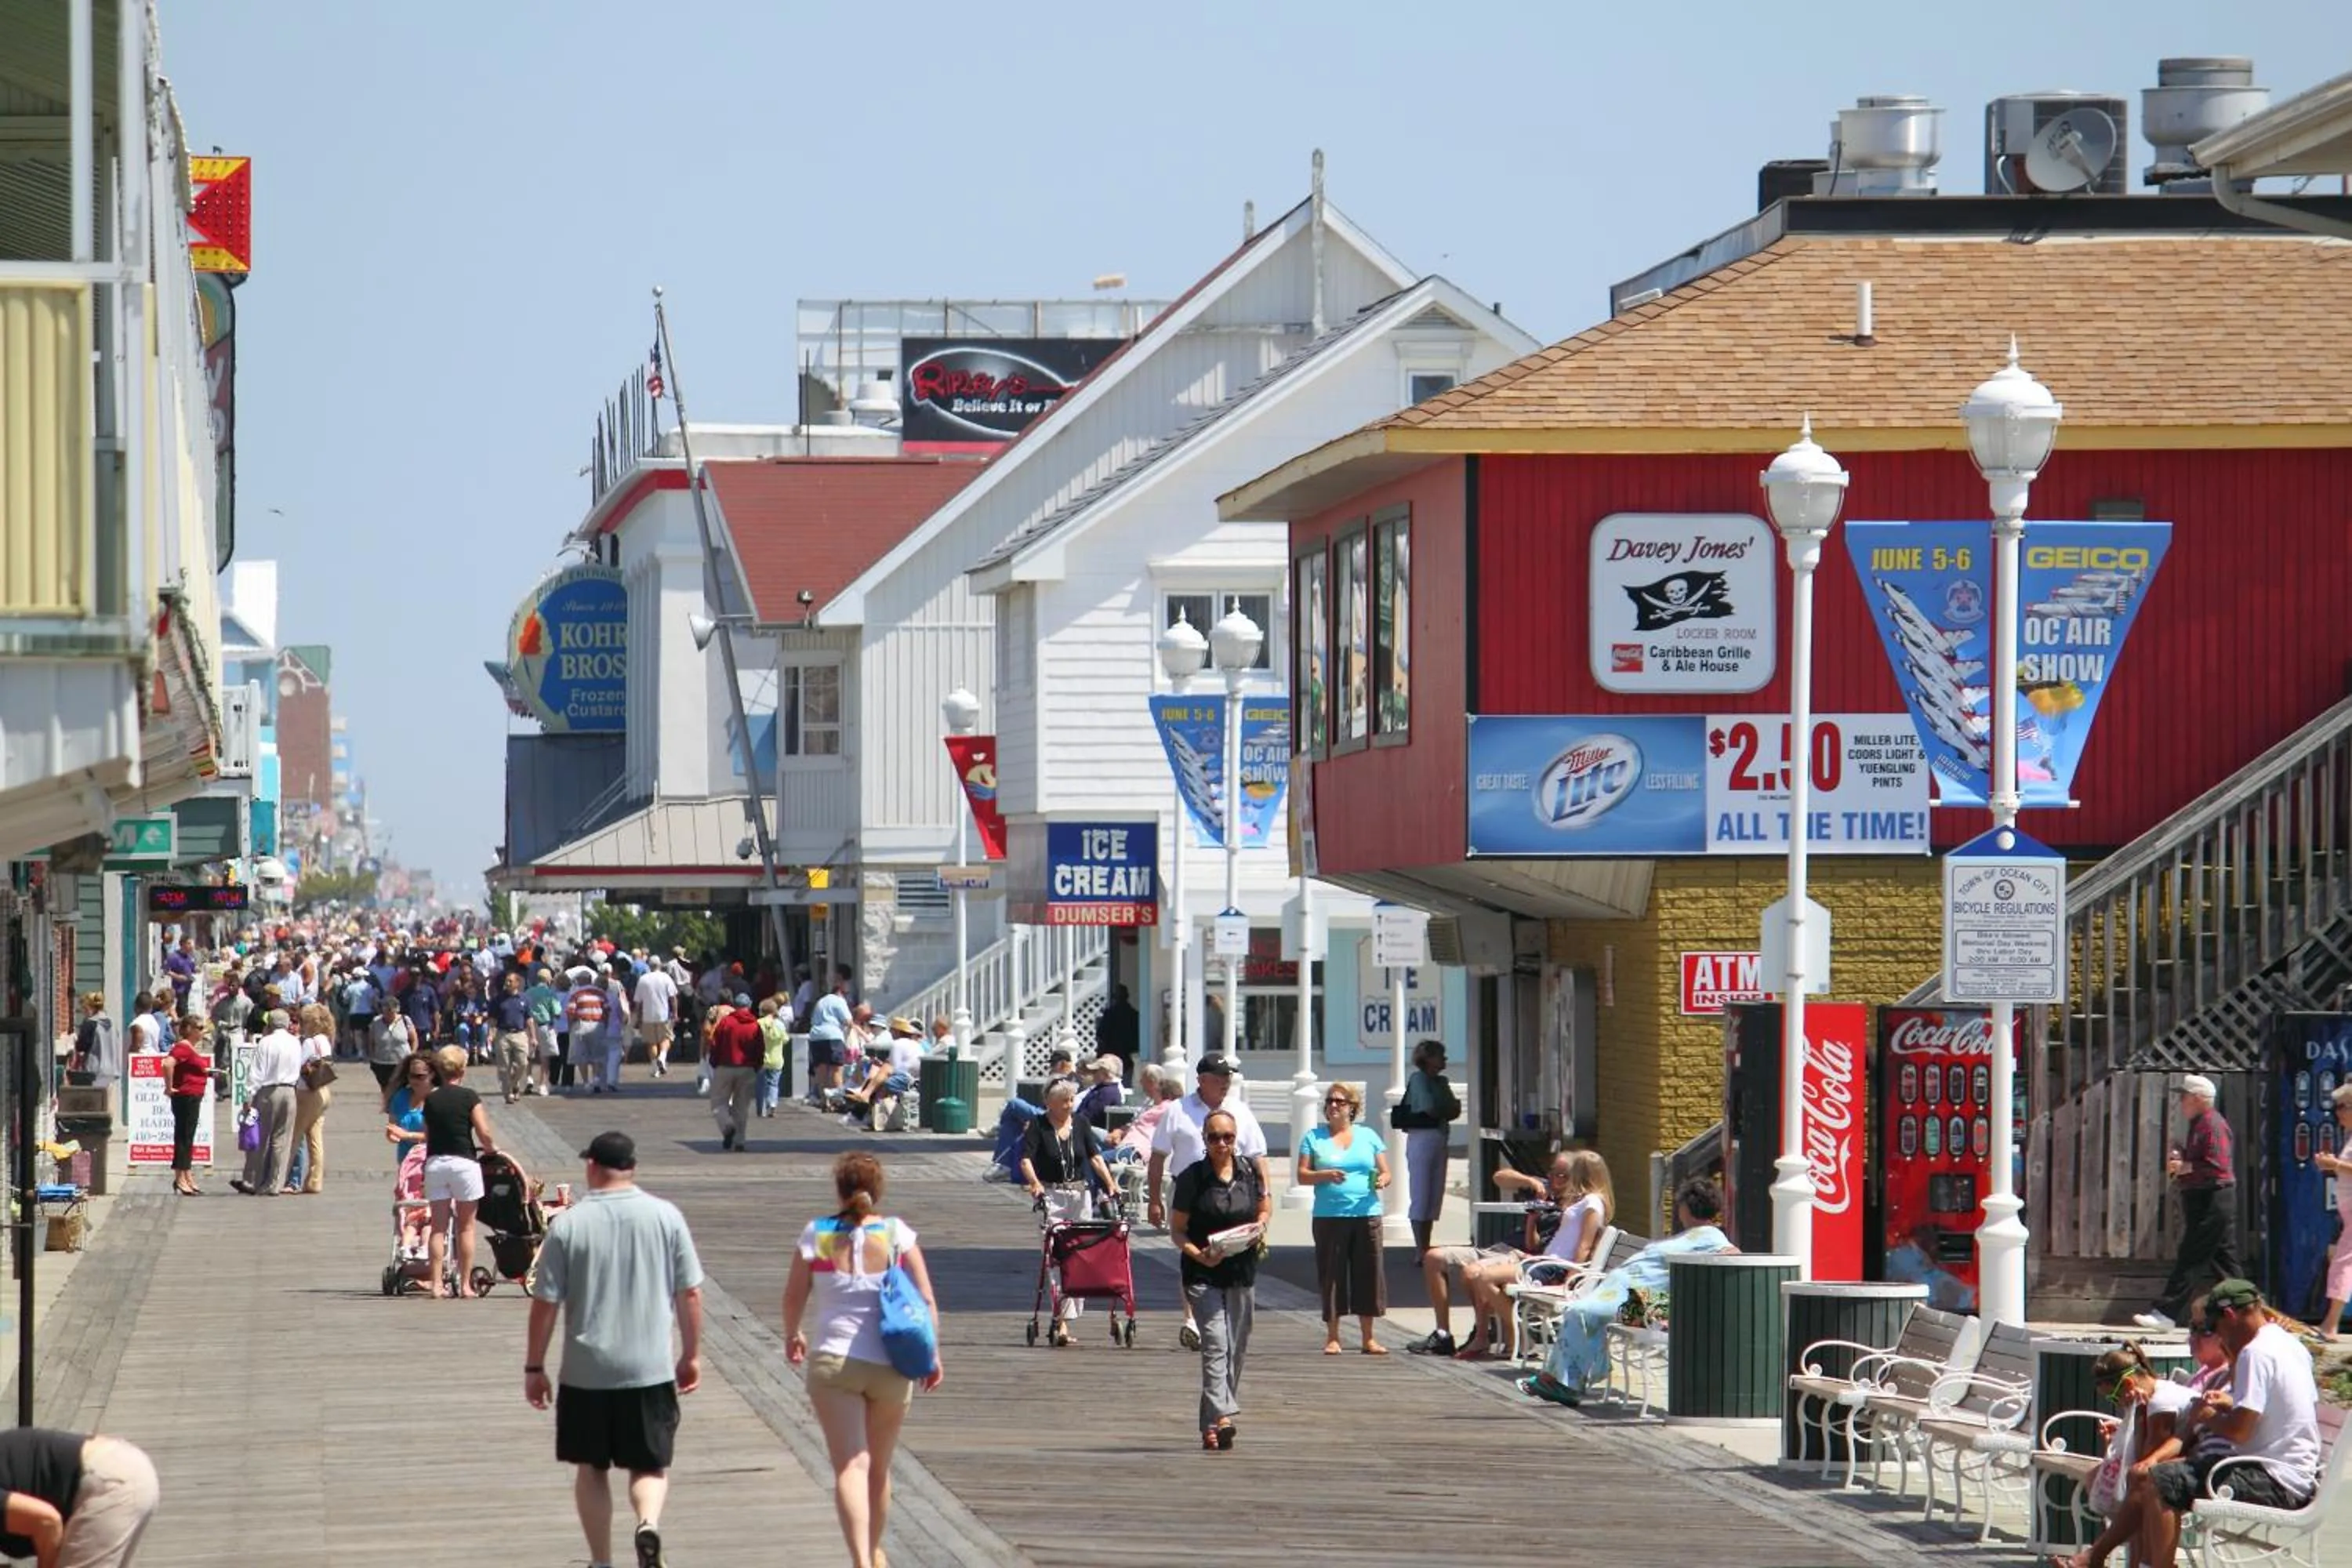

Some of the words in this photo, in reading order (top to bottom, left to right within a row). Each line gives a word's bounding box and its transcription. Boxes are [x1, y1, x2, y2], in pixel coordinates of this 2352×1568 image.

[952, 398, 1006, 413] Believe
[1009, 398, 1023, 412] It
[1025, 401, 1044, 413] or
[1606, 538, 1682, 563] Davey
[1682, 535, 1755, 563] Jones'
[1871, 548, 1922, 571] JUNE
[1932, 548, 1970, 571] 5-6
[2027, 546, 2149, 570] GEICO
[559, 622, 627, 648] KOHR
[1675, 628, 1719, 640] LOCKER
[1725, 628, 1757, 640] ROOM
[2024, 617, 2060, 646] OC
[2066, 618, 2111, 646] AIR
[1650, 645, 1713, 659] Caribbean
[1717, 645, 1751, 659] Grille
[560, 652, 627, 681] BROS
[1661, 660, 1671, 672] &
[1675, 659, 1696, 673] Ale
[1699, 659, 1739, 673] House
[2023, 654, 2105, 682] SHOW
[571, 688, 626, 702] Frozen
[1244, 708, 1290, 721] GEIC
[1854, 735, 1893, 746] MILLER
[1243, 746, 1263, 762] OC
[1566, 747, 1614, 774] Miller
[1848, 749, 1882, 760] COORS
[1886, 749, 1915, 760] LIGHT
[1241, 764, 1288, 782] SHOW
[1859, 763, 1916, 775] YUENGLING
[1552, 758, 1628, 823] Lite
[1872, 776, 1903, 788] PINTS
[1716, 812, 1768, 841] ALL
[1842, 812, 1926, 840] TIME!
[1081, 829, 1129, 861] ICE
[1054, 863, 1151, 897] CREAM
[2000, 868, 2032, 883] OCEAN
[2033, 878, 2051, 896] CITY
[1054, 906, 1152, 924] DUMSER'S
[1953, 902, 1991, 914] BICYCLE
[1994, 902, 2056, 915] REGULATIONS
[1385, 967, 1418, 989] IE
[1693, 956, 1762, 990] ATM
[1364, 1004, 1436, 1033] CRAM
[1891, 1017, 1994, 1055] Coca-Co
